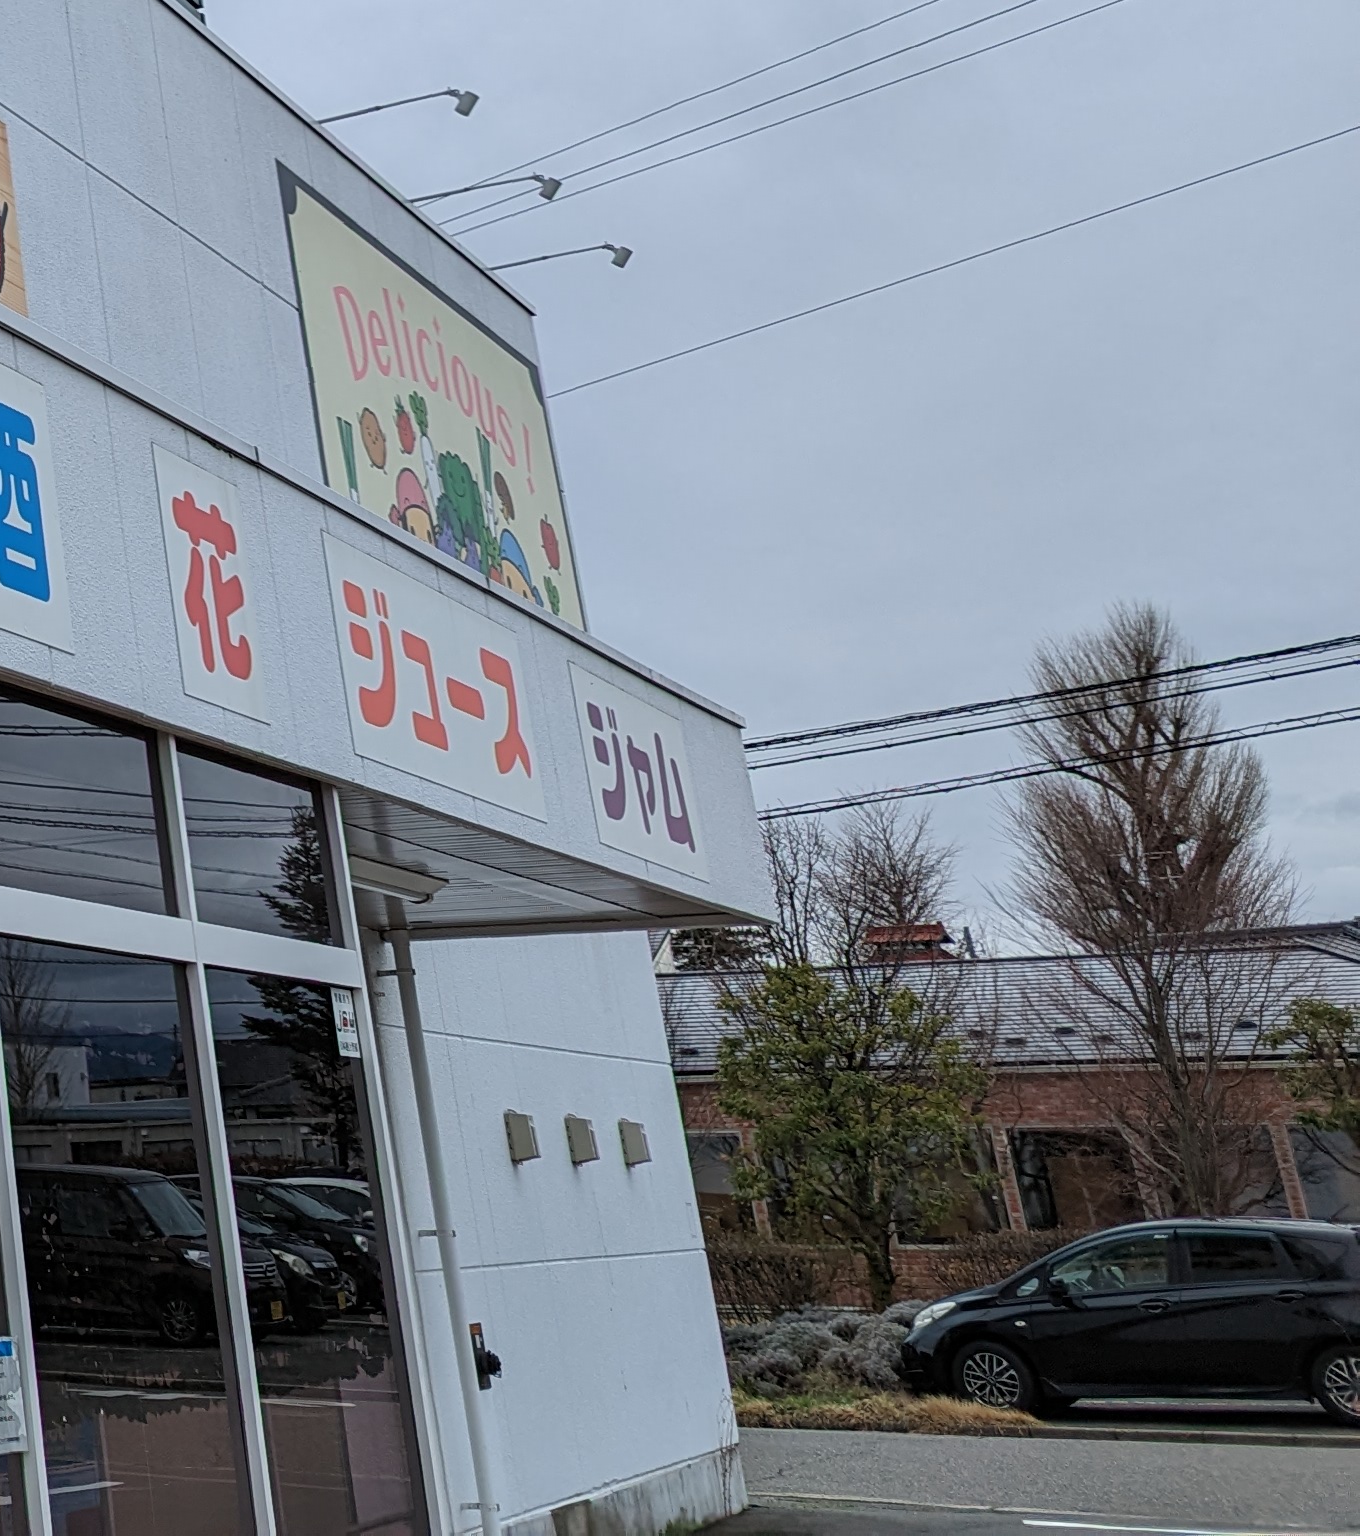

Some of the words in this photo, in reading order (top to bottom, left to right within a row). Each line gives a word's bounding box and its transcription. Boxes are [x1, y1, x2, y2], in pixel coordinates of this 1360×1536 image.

[172, 490, 252, 681] 花
[342, 579, 532, 779] ジュース
[586, 700, 697, 854] ジャム
